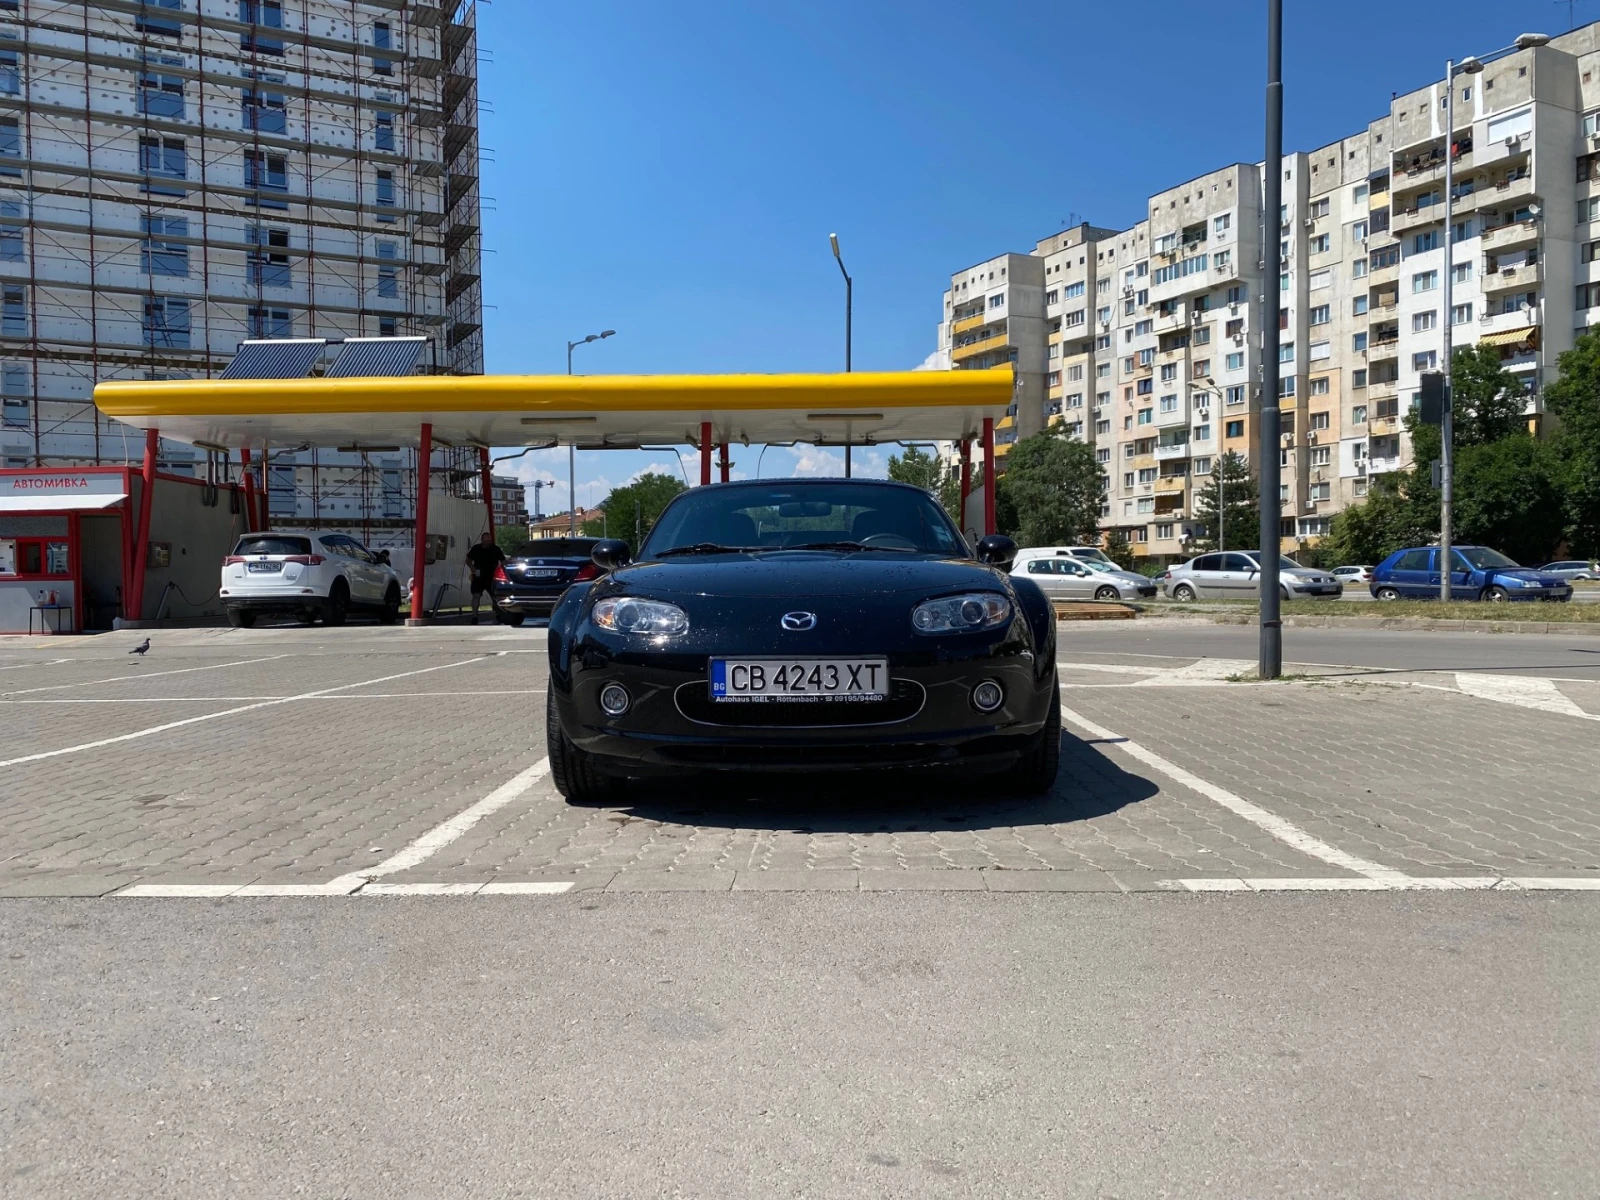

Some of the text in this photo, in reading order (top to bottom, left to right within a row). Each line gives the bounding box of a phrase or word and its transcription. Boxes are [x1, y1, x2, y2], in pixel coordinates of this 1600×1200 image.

[13, 477, 88, 488] АВТОМИВКА
[731, 664, 882, 691] CB 4243 XT
[713, 682, 725, 691] BG
[776, 695, 819, 703] Röttenbach
